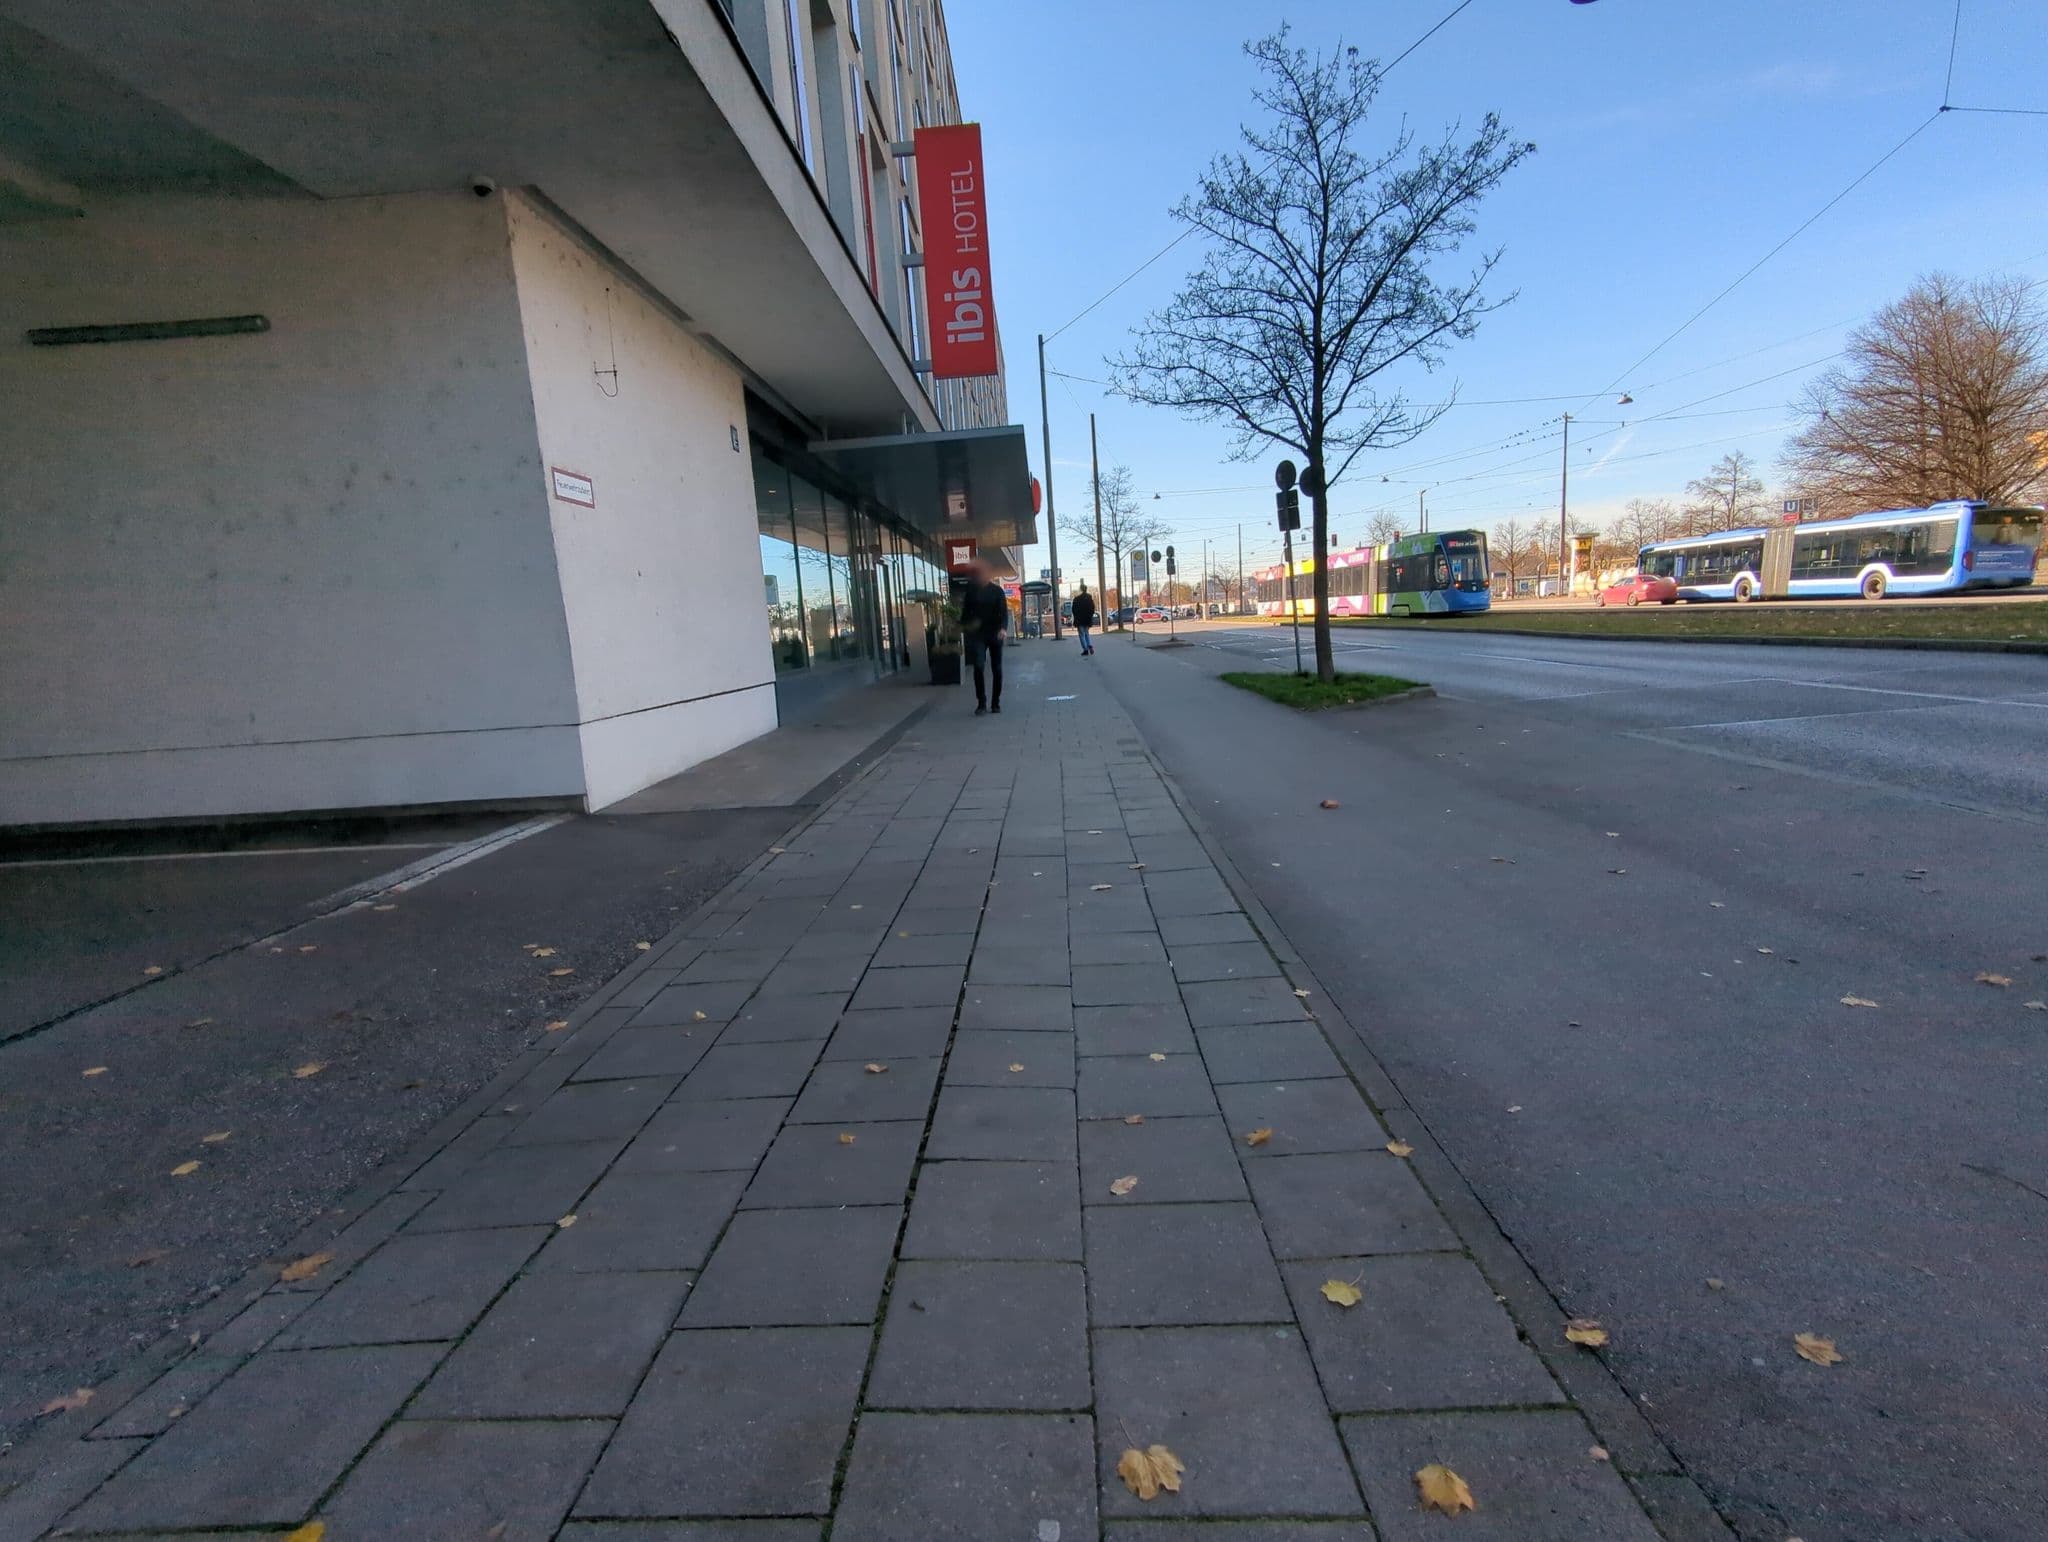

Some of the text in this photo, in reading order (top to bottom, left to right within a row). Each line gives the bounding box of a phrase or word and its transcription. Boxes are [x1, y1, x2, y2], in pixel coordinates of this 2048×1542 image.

[944, 160, 985, 343] ibis HOTEL
[1787, 501, 1796, 511] U
[955, 551, 968, 560] ibis
